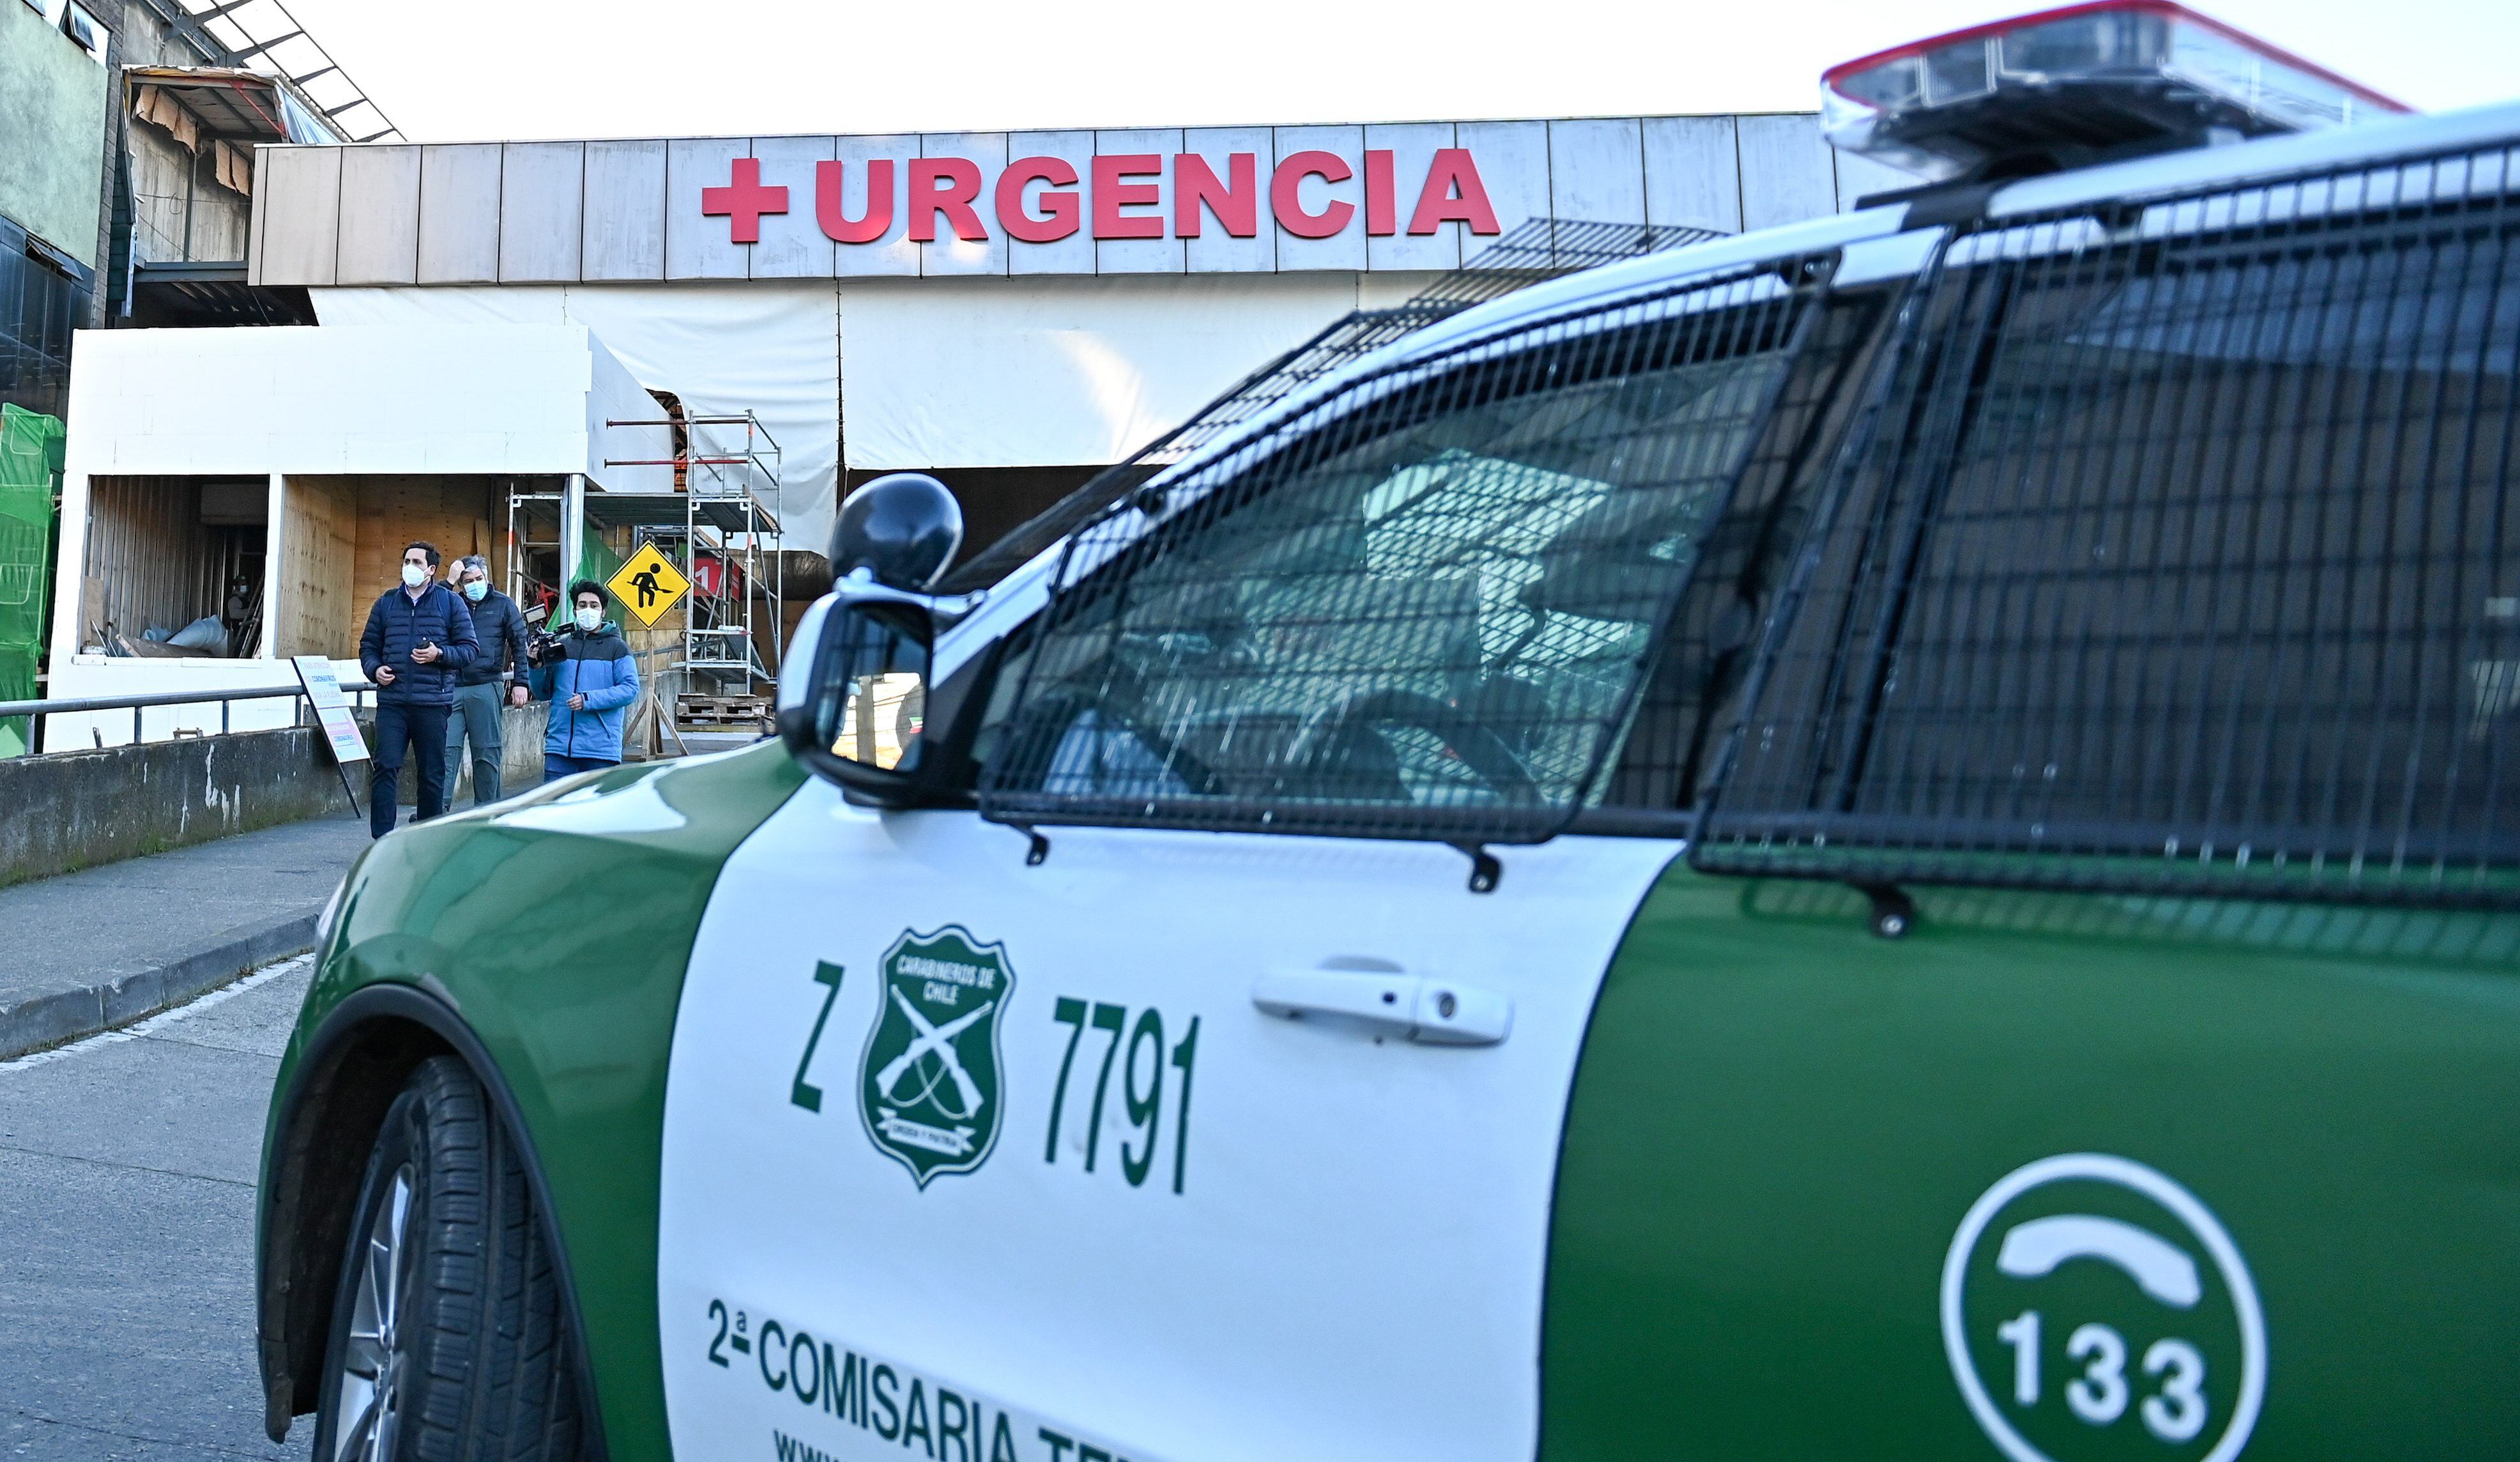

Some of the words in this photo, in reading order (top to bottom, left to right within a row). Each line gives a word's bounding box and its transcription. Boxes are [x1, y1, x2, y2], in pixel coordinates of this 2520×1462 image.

[815, 148, 1501, 243] URGENCIA
[923, 981, 958, 1005] CHILE
[977, 967, 996, 989] DE
[790, 958, 846, 1114] Z
[1044, 995, 1201, 1196] 7791
[759, 1320, 1017, 1462] COMISARIA
[1996, 1310, 2208, 1443] 133
